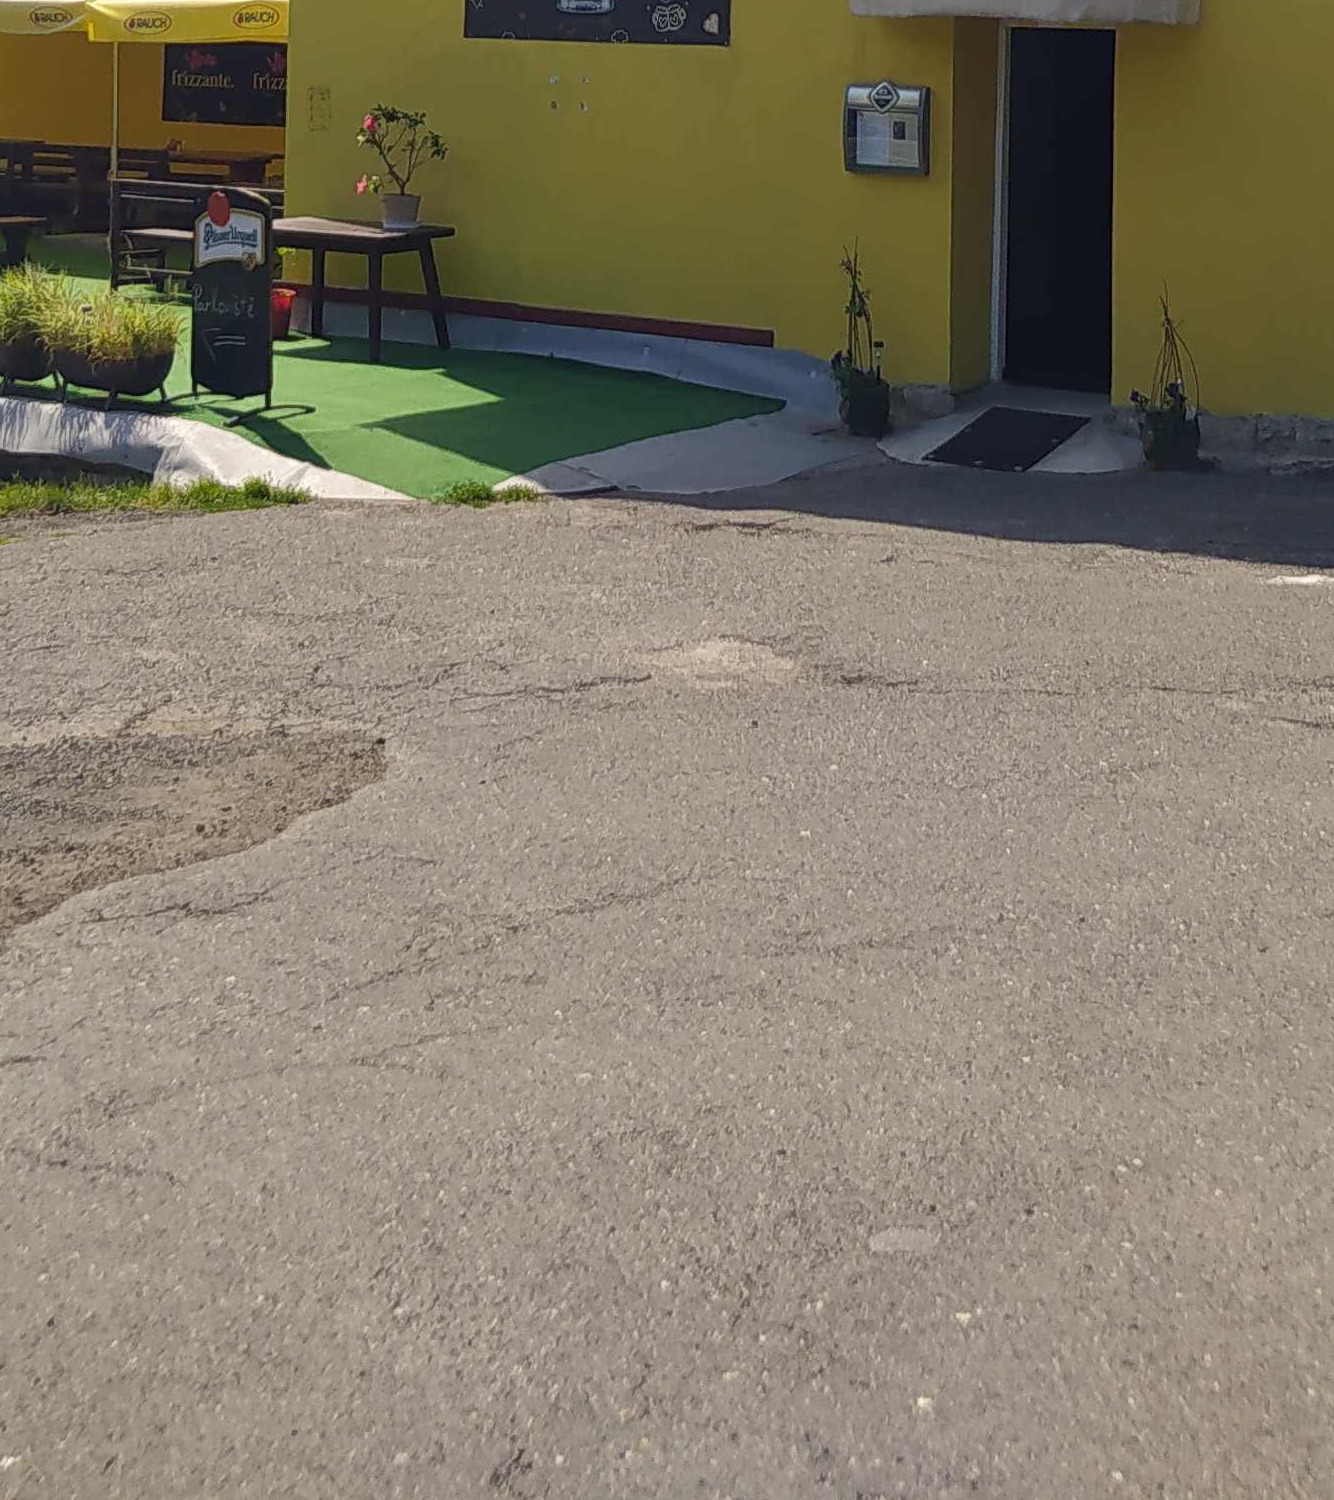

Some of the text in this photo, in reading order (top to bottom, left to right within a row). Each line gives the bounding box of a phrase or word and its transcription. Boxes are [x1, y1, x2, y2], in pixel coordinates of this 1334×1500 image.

[40, 11, 67, 23] RAUCH
[135, 16, 167, 30] RAUCH
[243, 11, 275, 24] RAUCH
[171, 69, 288, 90] frizzante. frizz
